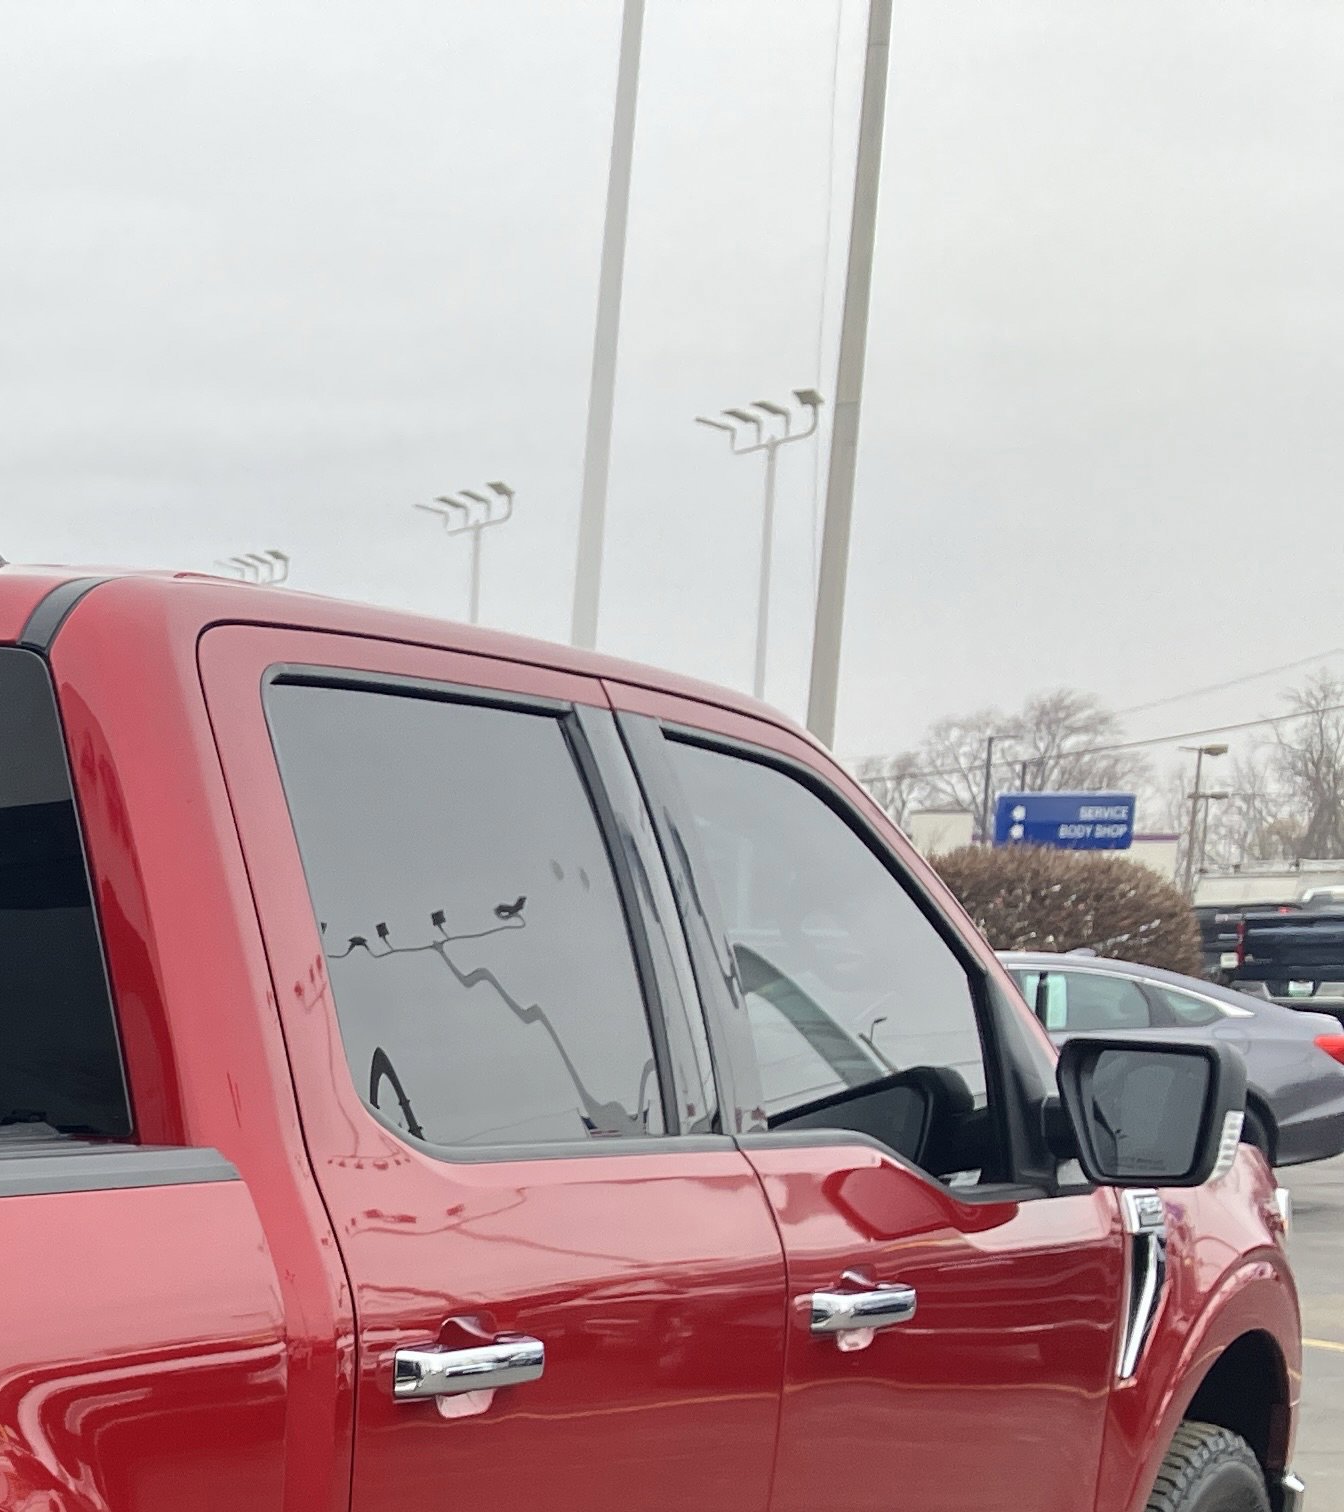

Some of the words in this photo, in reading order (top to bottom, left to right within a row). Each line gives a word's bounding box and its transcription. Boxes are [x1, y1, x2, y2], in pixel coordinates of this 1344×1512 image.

[1079, 805, 1129, 821] SERVICE
[1059, 823, 1094, 839] BODY
[1094, 823, 1128, 839] SHOP
